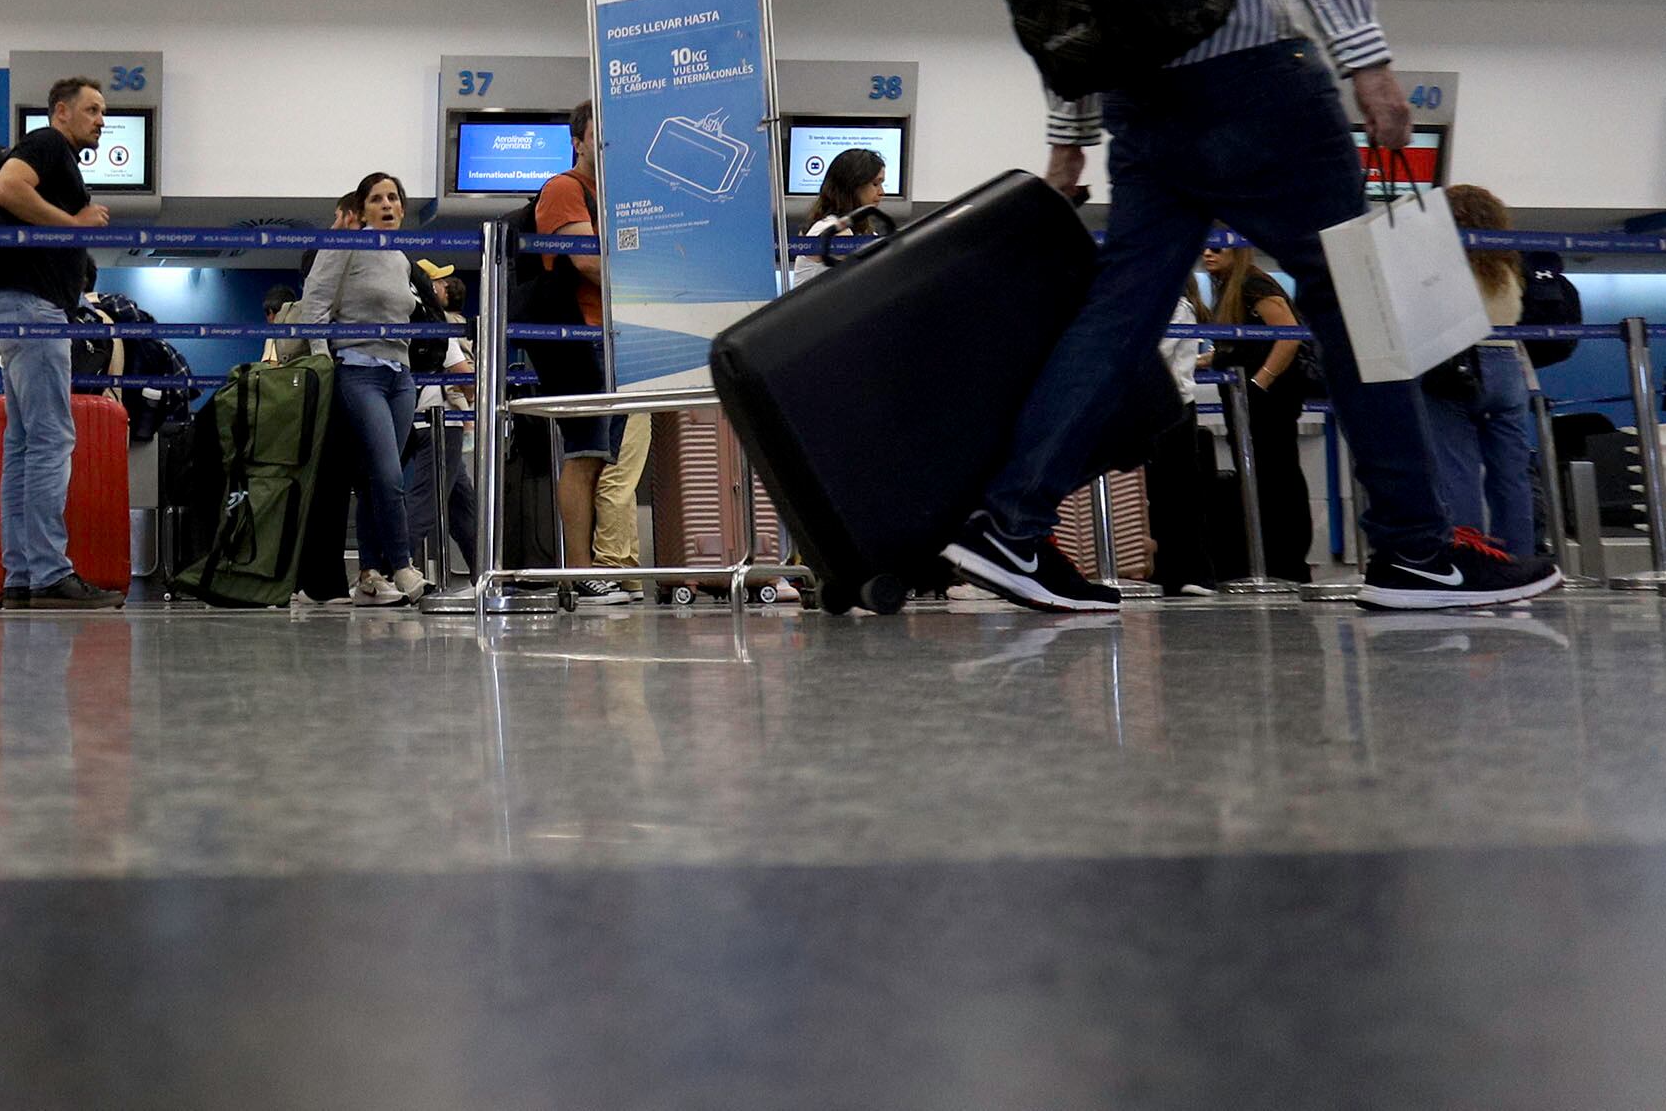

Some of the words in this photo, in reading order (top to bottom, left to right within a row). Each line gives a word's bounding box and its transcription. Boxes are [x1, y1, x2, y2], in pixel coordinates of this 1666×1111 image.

[643, 18, 682, 34] LLEVAR
[684, 10, 720, 26] HASTA
[672, 62, 710, 76] VUELOS
[673, 64, 754, 86] INTERNACIONALES
[110, 65, 146, 90] 36
[458, 70, 494, 97] 37
[610, 73, 642, 86] VUELOS
[610, 86, 622, 96] DE
[624, 78, 667, 93] CABOTAJE
[868, 75, 903, 100] 38
[1409, 85, 1442, 109] 40
[468, 170, 515, 179] International
[615, 201, 631, 210] UNA
[32, 232, 75, 242] despegar
[154, 233, 196, 242] despegar
[275, 234, 316, 243] despegar
[394, 236, 434, 245] despegar
[534, 240, 574, 250] despegar
